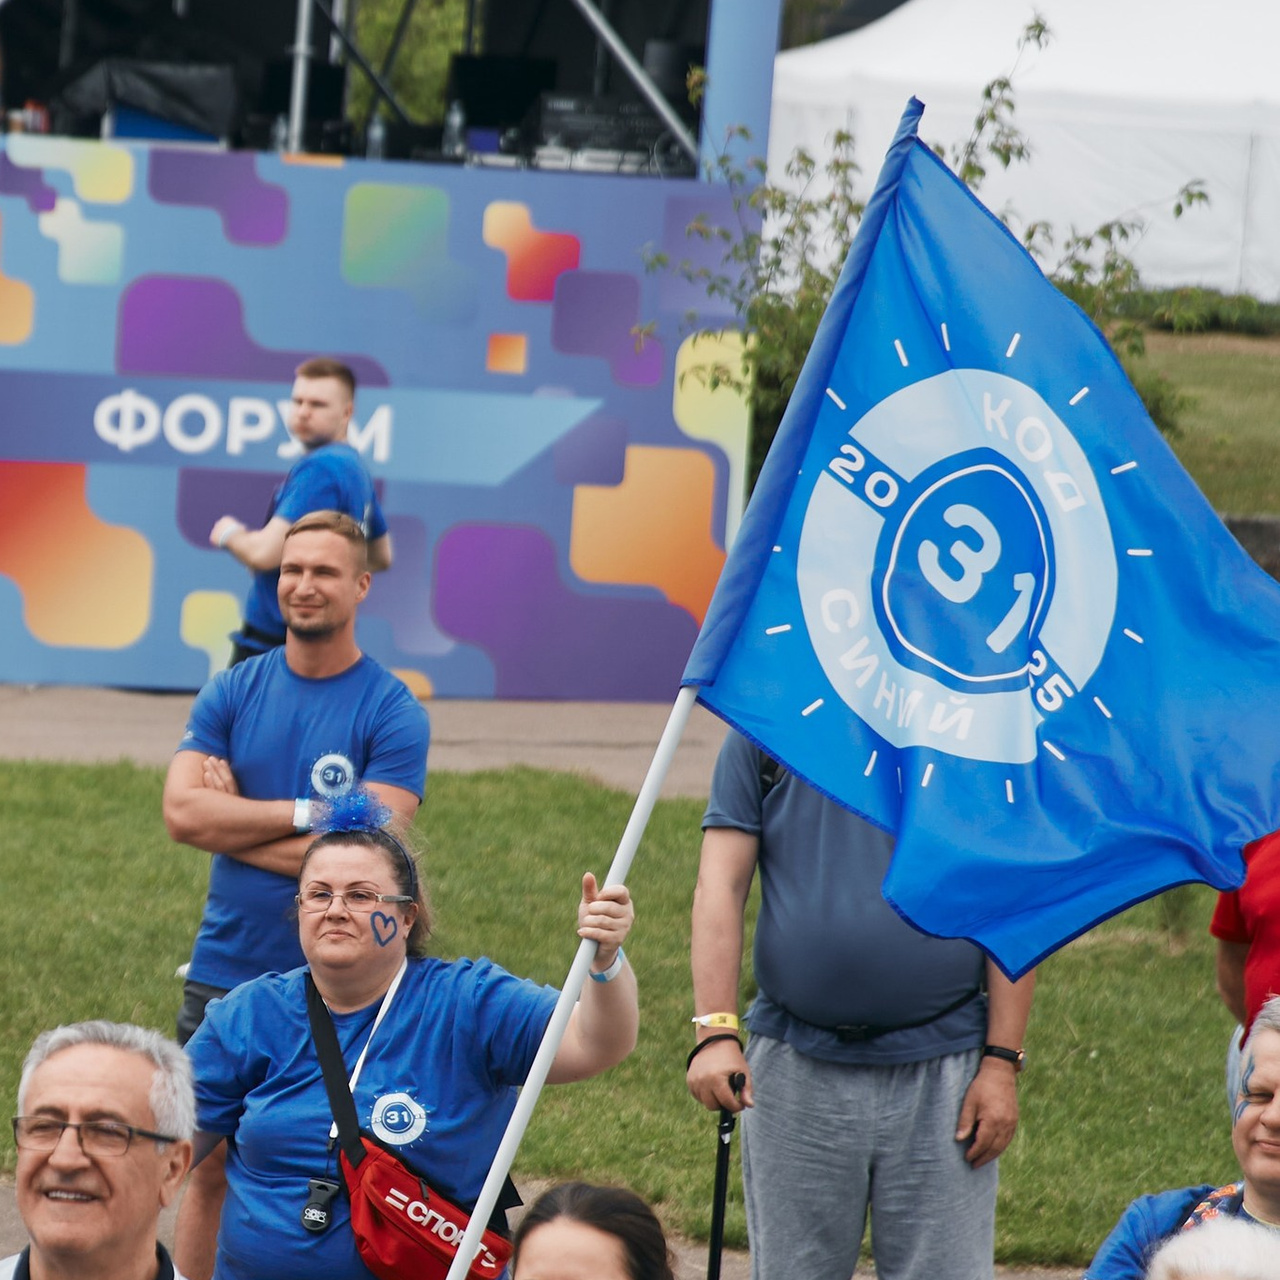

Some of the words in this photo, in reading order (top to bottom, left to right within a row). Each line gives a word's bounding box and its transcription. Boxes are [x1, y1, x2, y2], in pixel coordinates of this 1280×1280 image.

[828, 443, 899, 508] 20
[982, 391, 1087, 513] КОД
[917, 503, 1037, 654] 31
[820, 588, 975, 741] СИНИЙ
[323, 768, 343, 783] 31
[386, 1110, 410, 1125] 31
